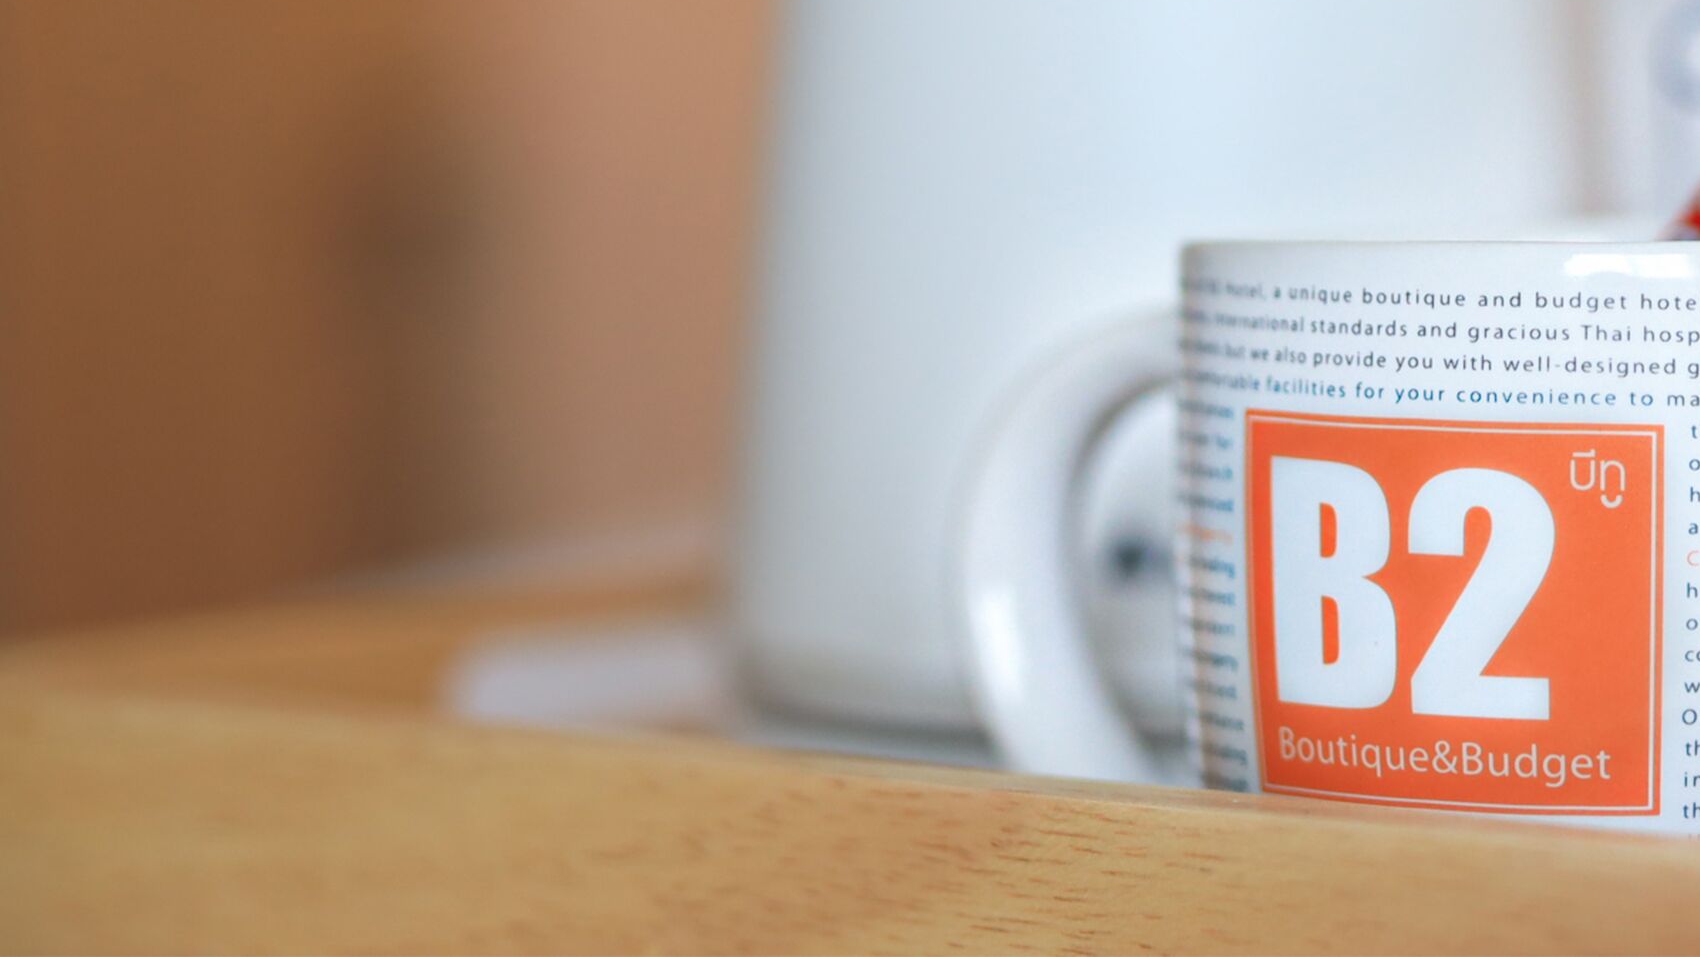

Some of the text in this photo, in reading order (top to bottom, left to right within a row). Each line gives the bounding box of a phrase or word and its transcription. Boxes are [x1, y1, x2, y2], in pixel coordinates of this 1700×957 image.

[1273, 288, 1281, 300] a
[1289, 288, 1353, 306] unique
[1362, 288, 1466, 309] boutique
[1478, 292, 1521, 308] and
[1535, 291, 1628, 313] budget
[1311, 318, 1408, 337] standards
[1417, 323, 1456, 338] and
[1468, 325, 1570, 343] gracious
[1582, 325, 1631, 342] Thai
[1250, 348, 1269, 362] we
[1275, 345, 1307, 364] also
[1313, 350, 1386, 369] provide
[1395, 356, 1433, 372] you
[1444, 355, 1492, 371] with
[1504, 356, 1676, 378] well-designed
[1267, 374, 1346, 398] facilities
[1356, 382, 1384, 400] for
[1395, 388, 1445, 404] your
[1457, 387, 1617, 406] convenience
[1630, 391, 1653, 407] to
[1270, 455, 1555, 720] B2
[1279, 726, 1611, 787] Boutique&Budget
